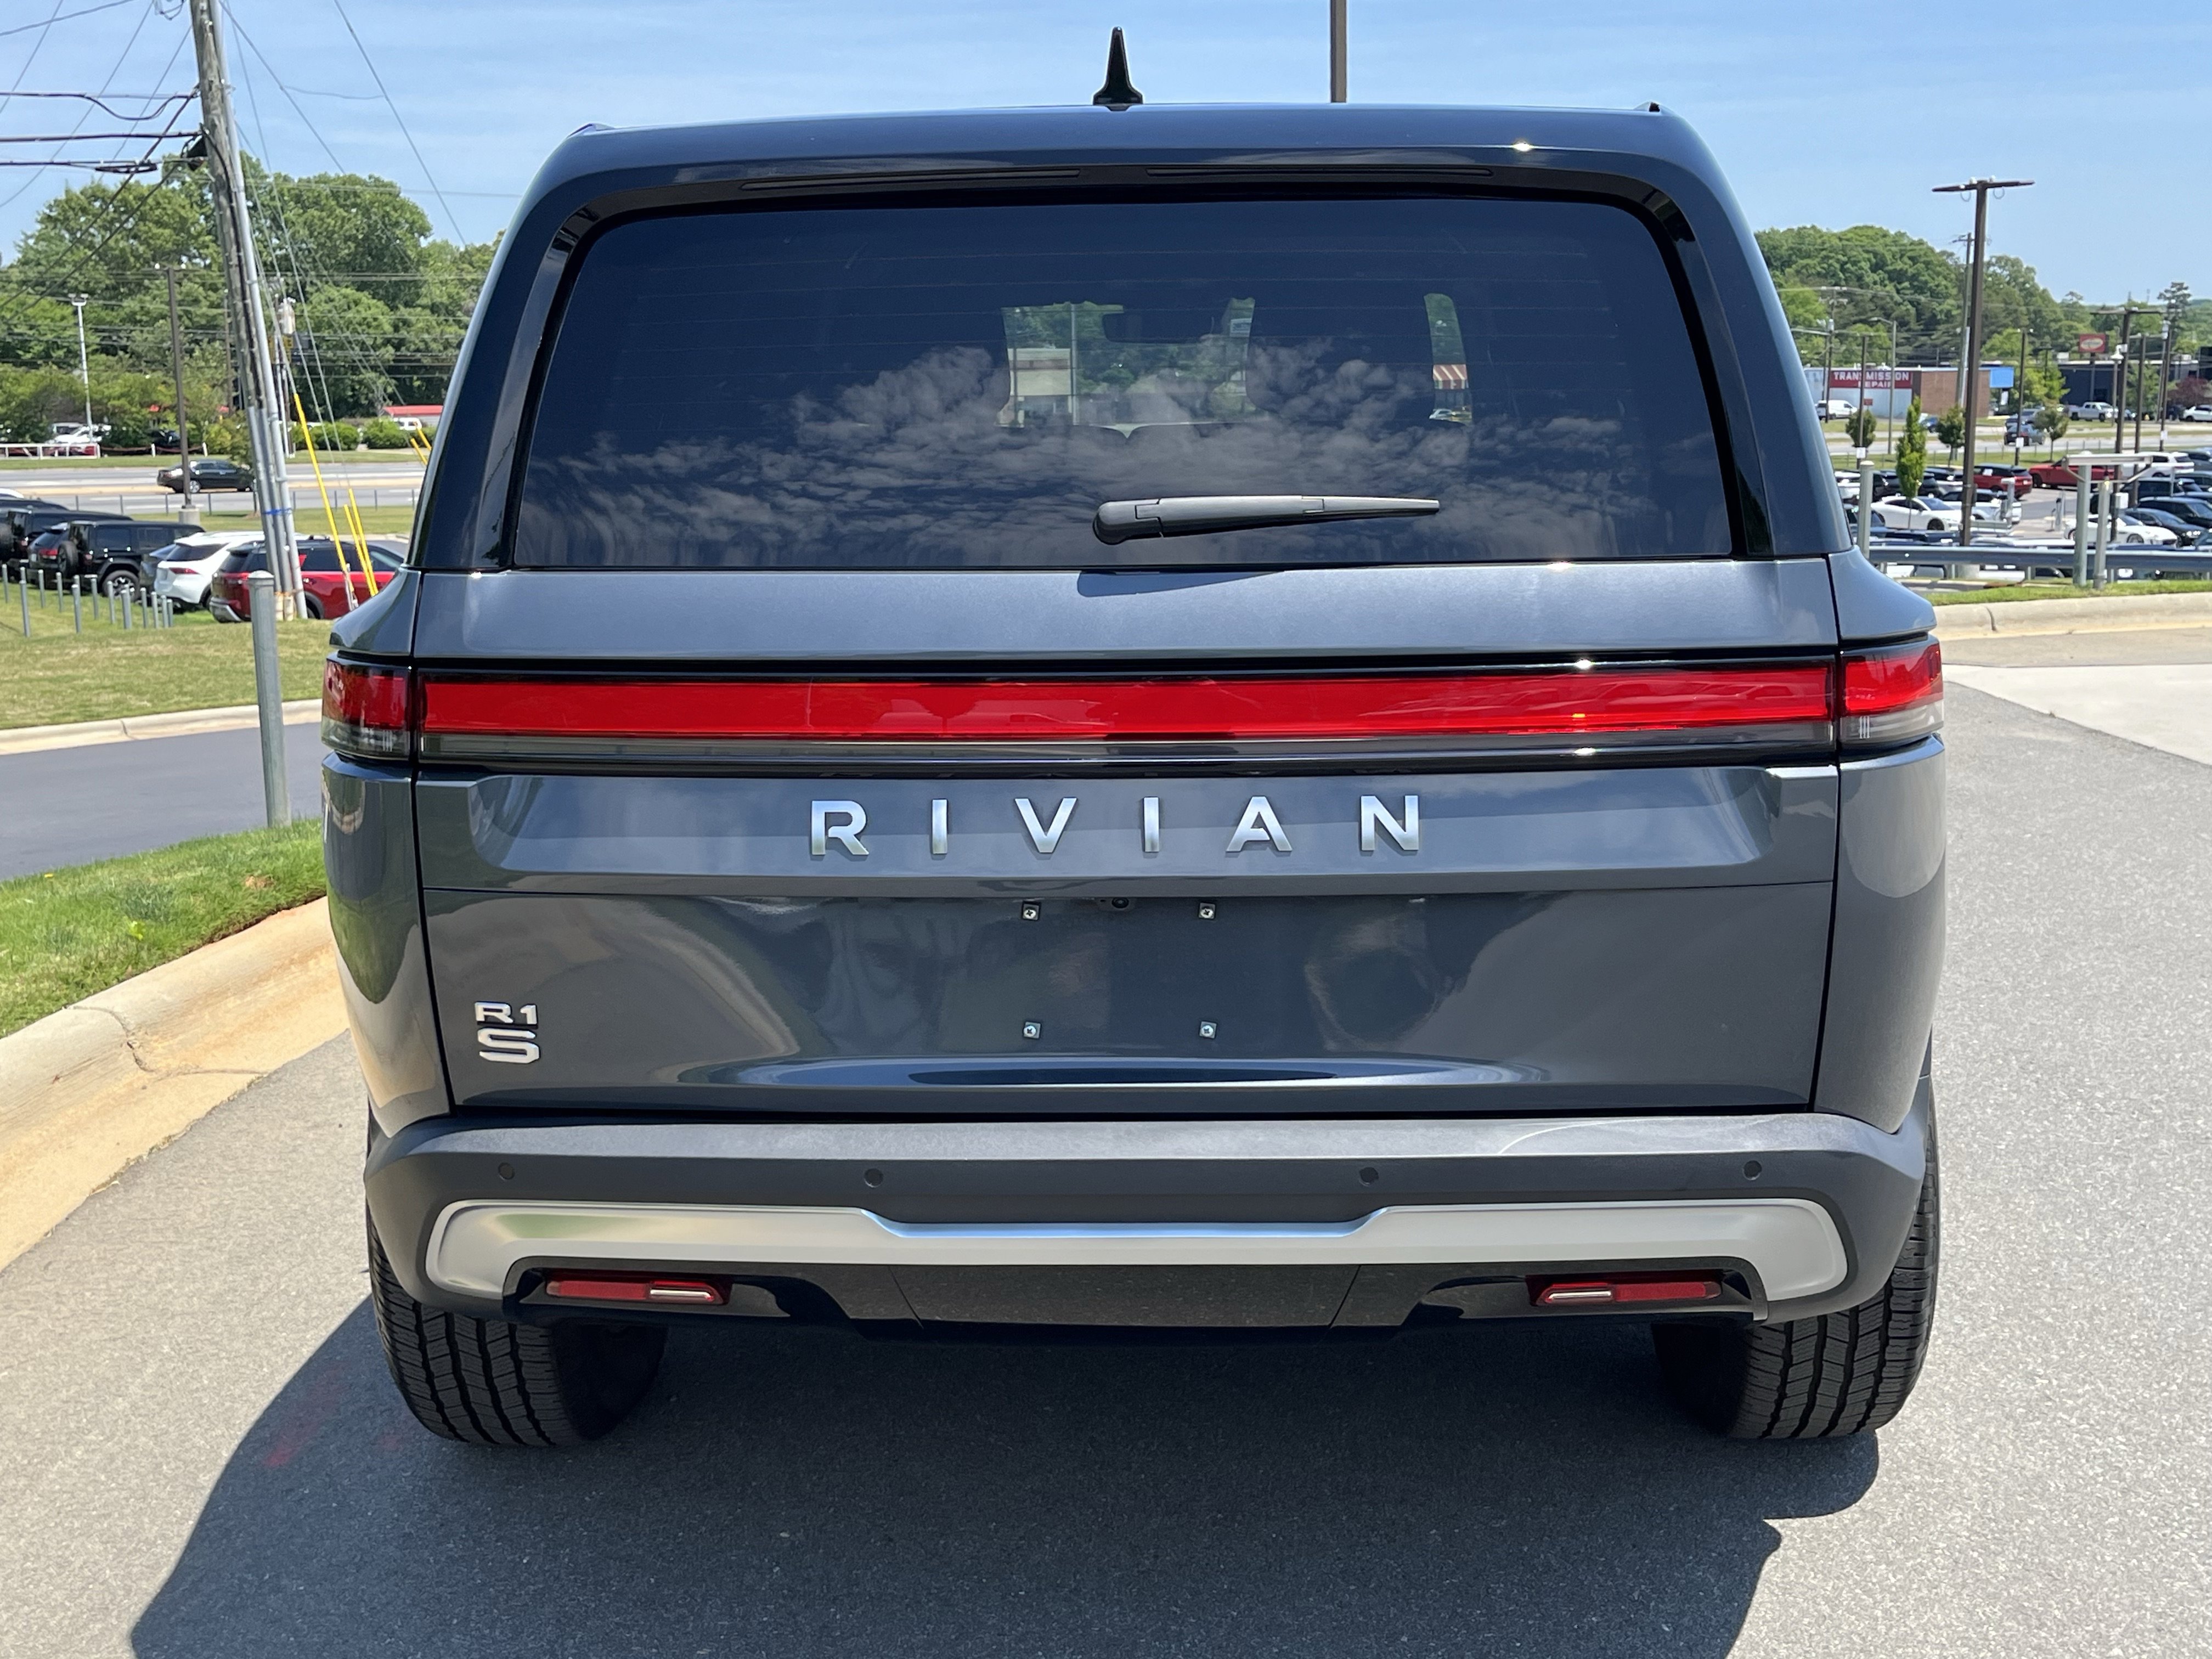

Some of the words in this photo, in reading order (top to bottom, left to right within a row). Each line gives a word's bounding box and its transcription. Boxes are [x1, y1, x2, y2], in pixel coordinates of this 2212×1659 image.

[1833, 371, 1909, 381] TRANMISSON
[811, 794, 1420, 856] RIVIAN
[474, 1002, 538, 1025] R1
[477, 1028, 540, 1064] S
